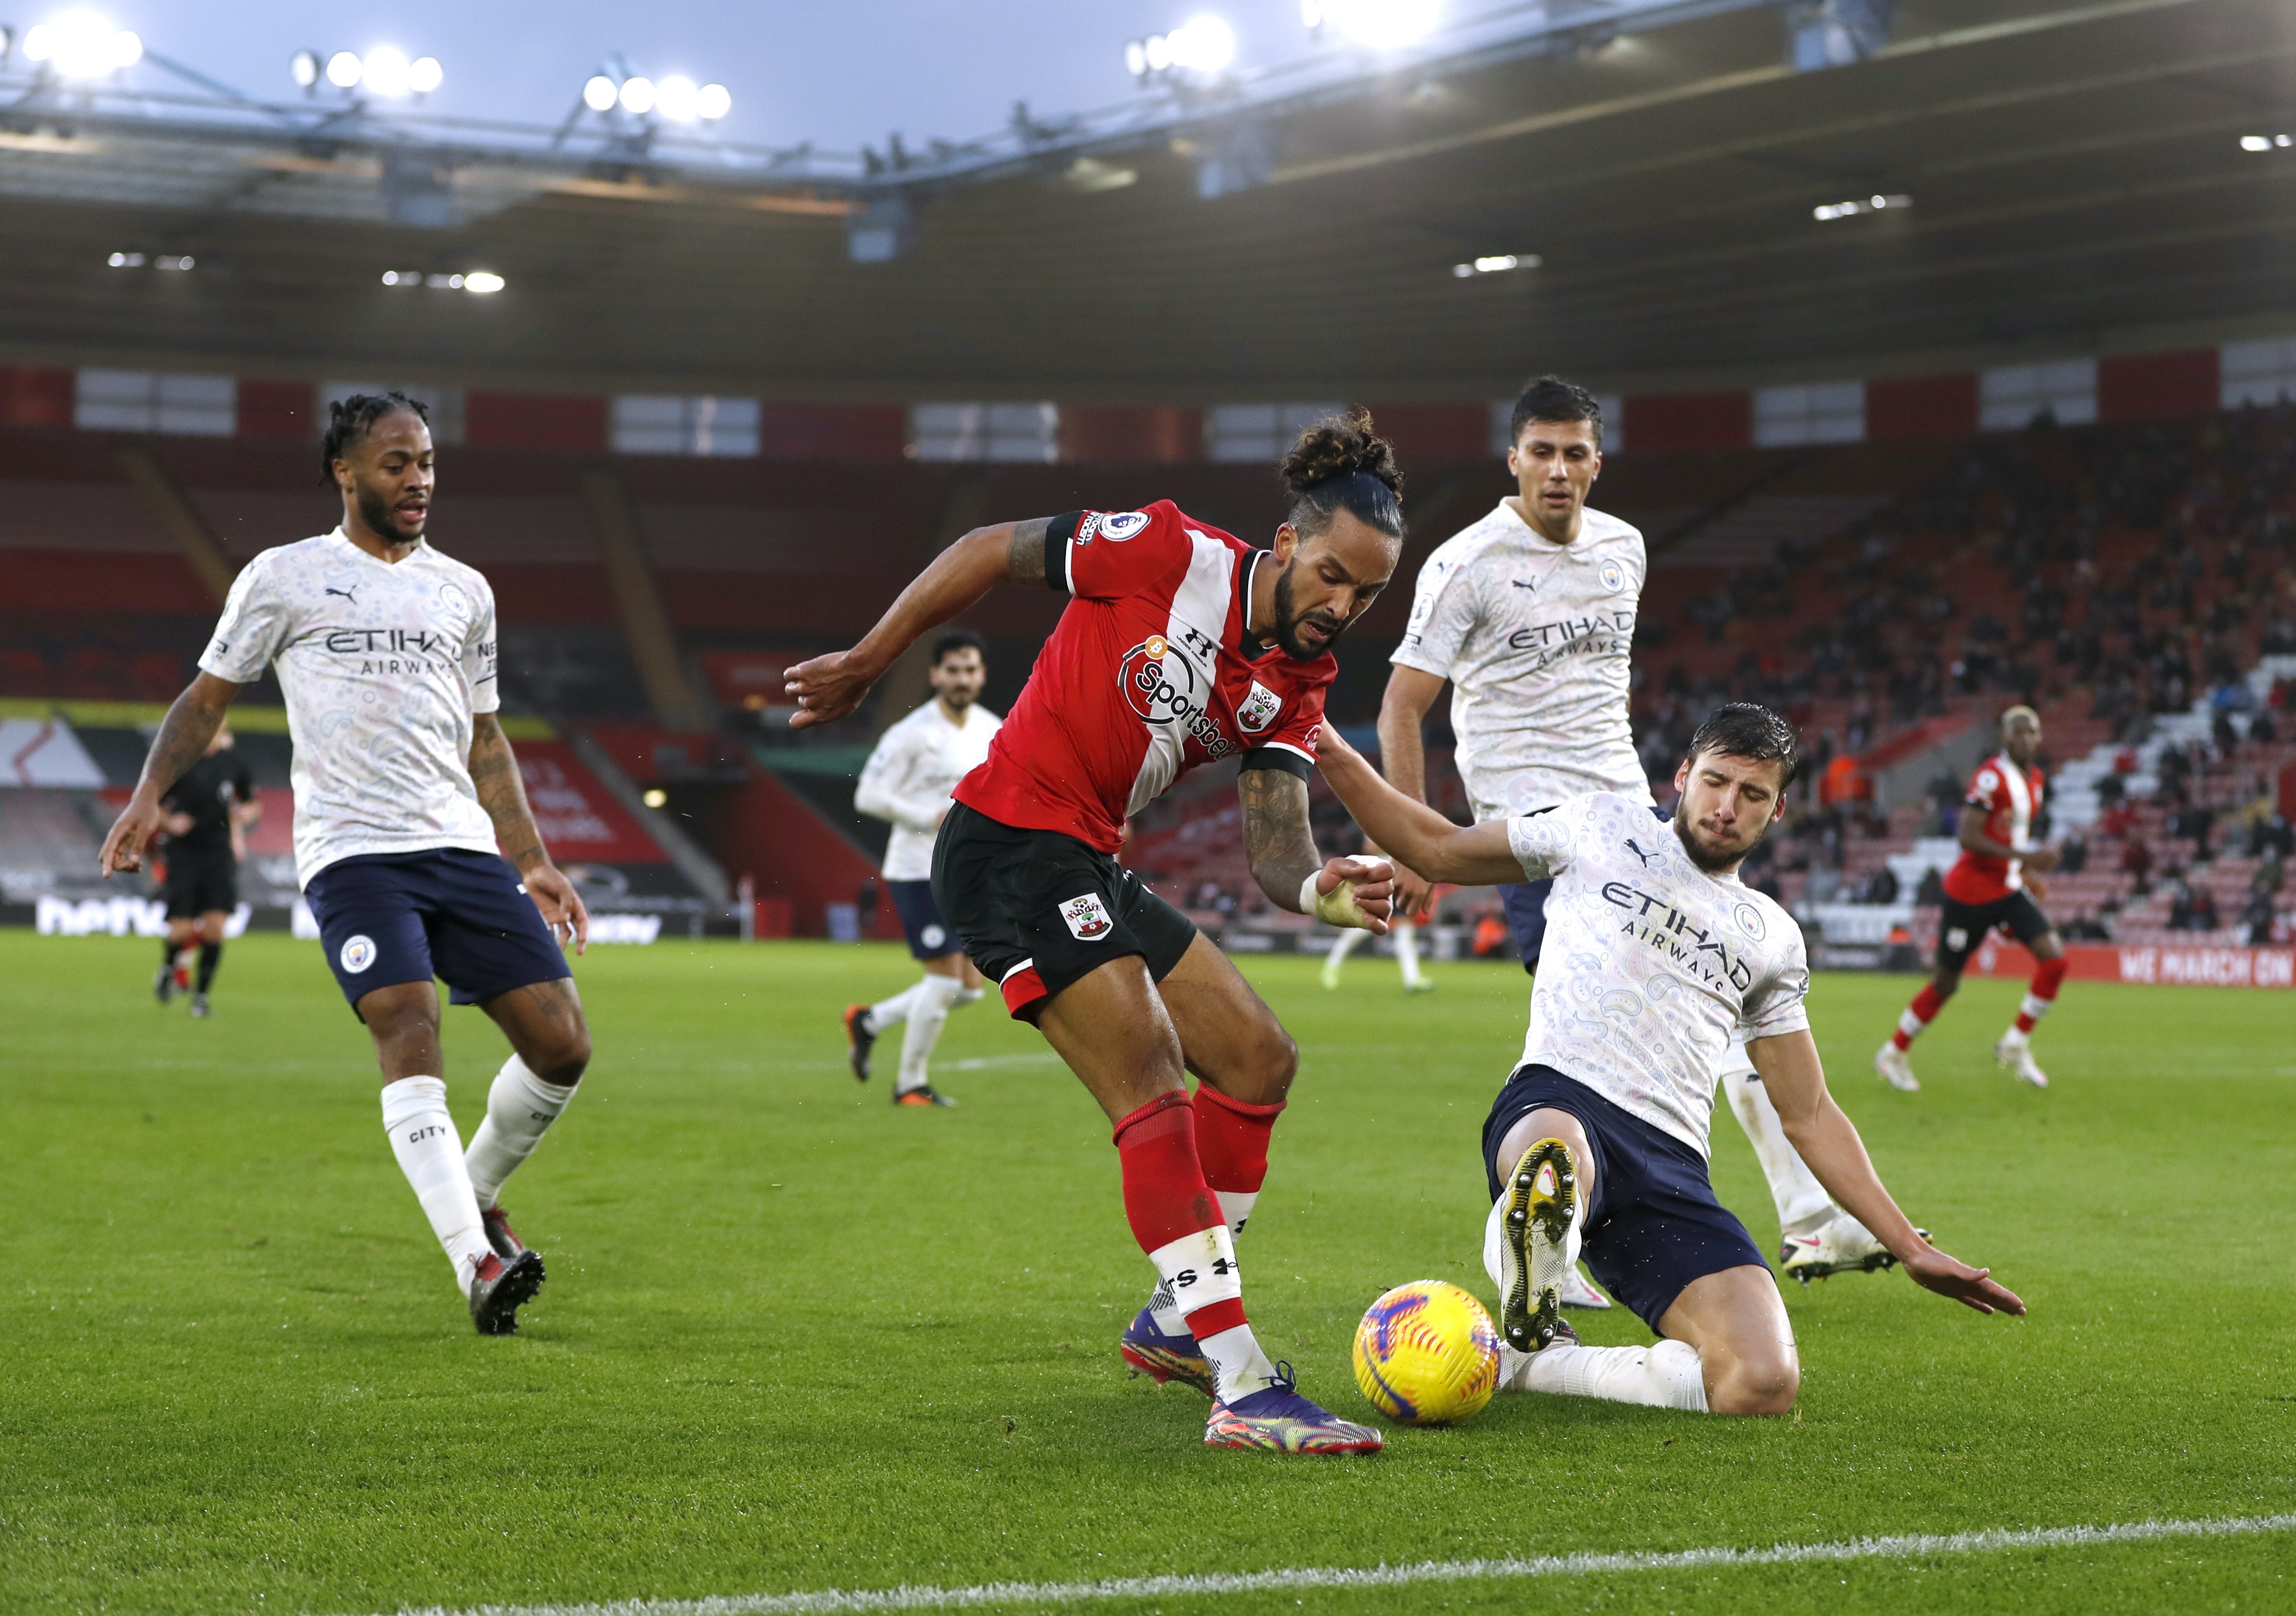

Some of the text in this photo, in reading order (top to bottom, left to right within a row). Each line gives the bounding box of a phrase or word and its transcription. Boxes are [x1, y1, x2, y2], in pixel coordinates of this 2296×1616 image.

[1509, 611, 1633, 649] ETIHAD
[1176, 635, 1207, 668] UNDER ARMOUR
[1602, 882, 1751, 991] ETIHAD
[2120, 947, 2155, 984] WE
[2254, 949, 2293, 986] ON
[409, 1126, 446, 1143] CITY
